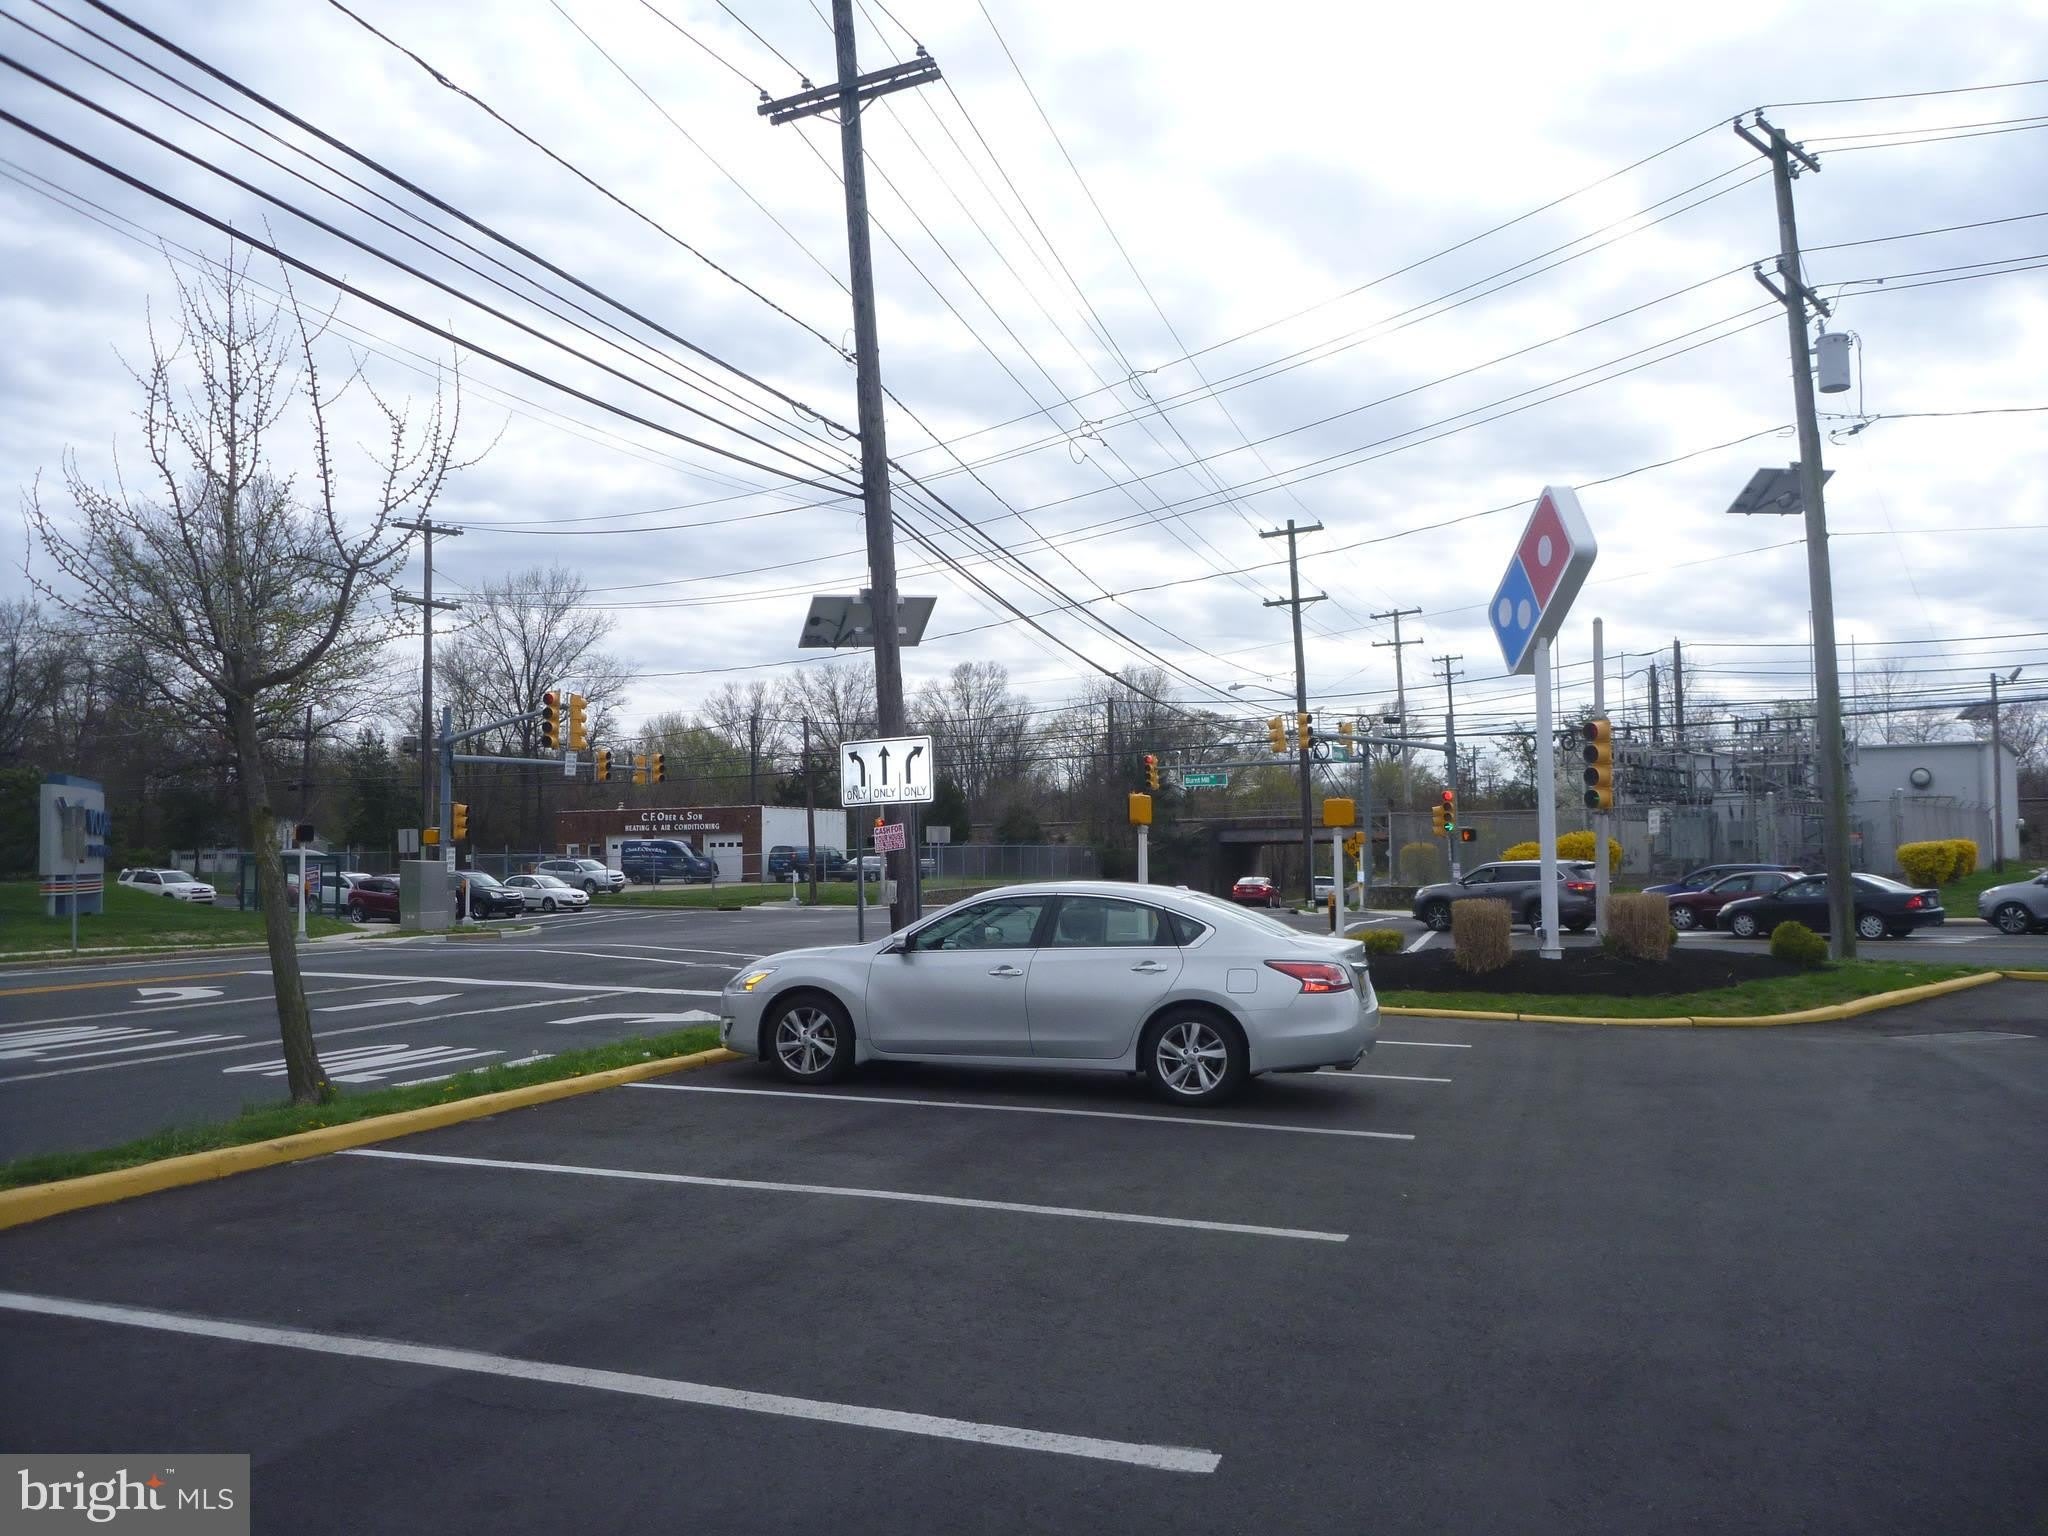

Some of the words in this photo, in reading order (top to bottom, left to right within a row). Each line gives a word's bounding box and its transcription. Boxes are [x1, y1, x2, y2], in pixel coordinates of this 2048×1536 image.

[847, 789, 867, 801] ONLY
[873, 787, 896, 798] ONLY
[904, 785, 927, 797] ONLY
[625, 824, 650, 832] HEATING
[674, 823, 720, 831] CONDITIONING
[875, 826, 890, 835] CASH
[891, 824, 903, 833] FOR
